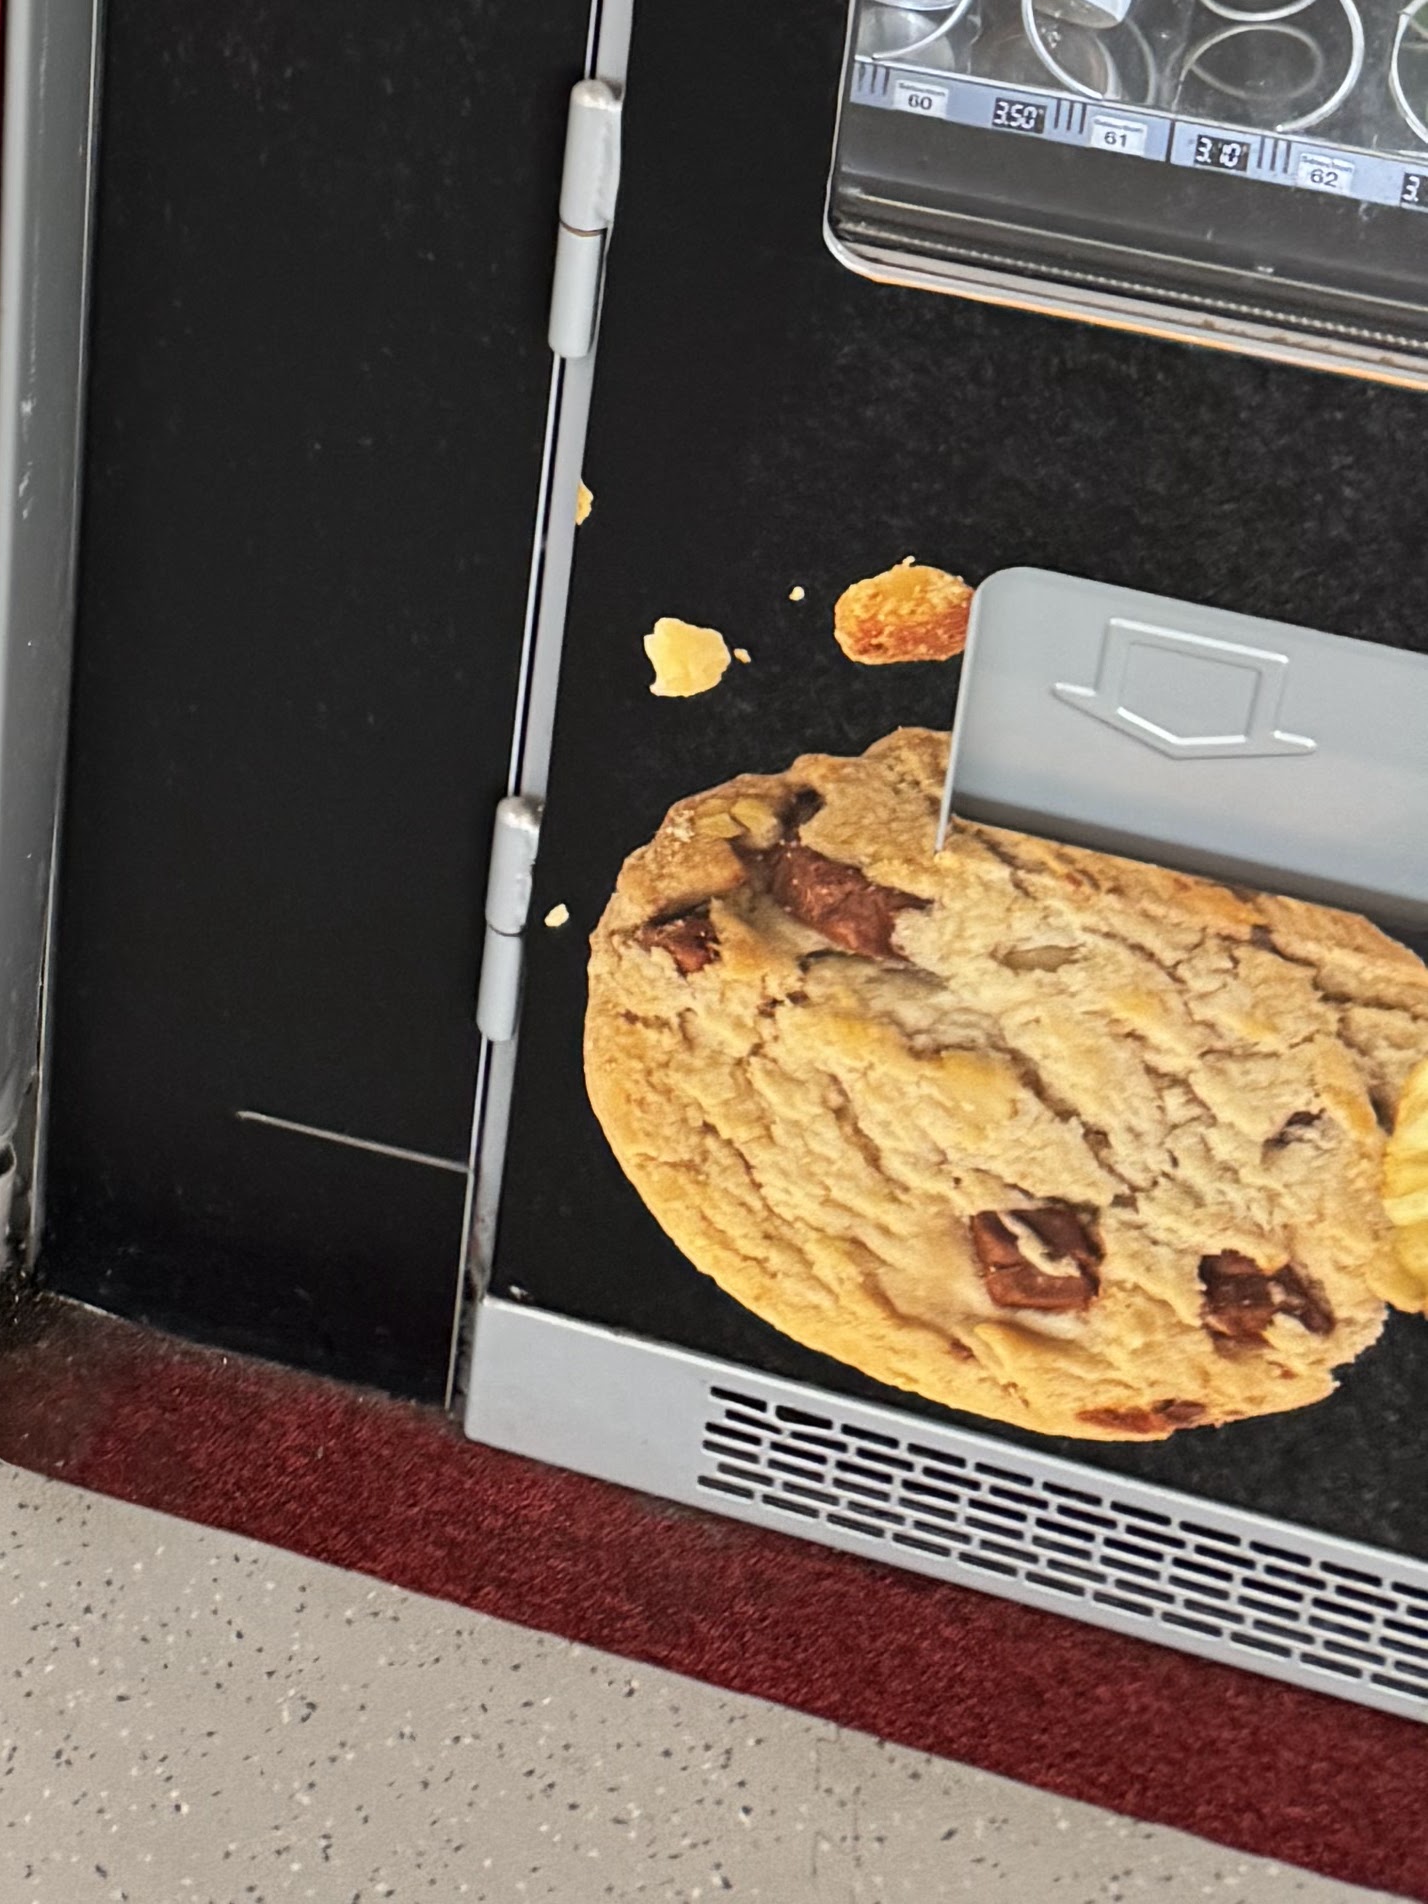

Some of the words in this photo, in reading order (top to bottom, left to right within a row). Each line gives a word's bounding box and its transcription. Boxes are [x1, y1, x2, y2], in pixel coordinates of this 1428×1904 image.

[908, 93, 933, 111] 60
[1104, 131, 1128, 147] 61
[1309, 168, 1339, 189] 62
